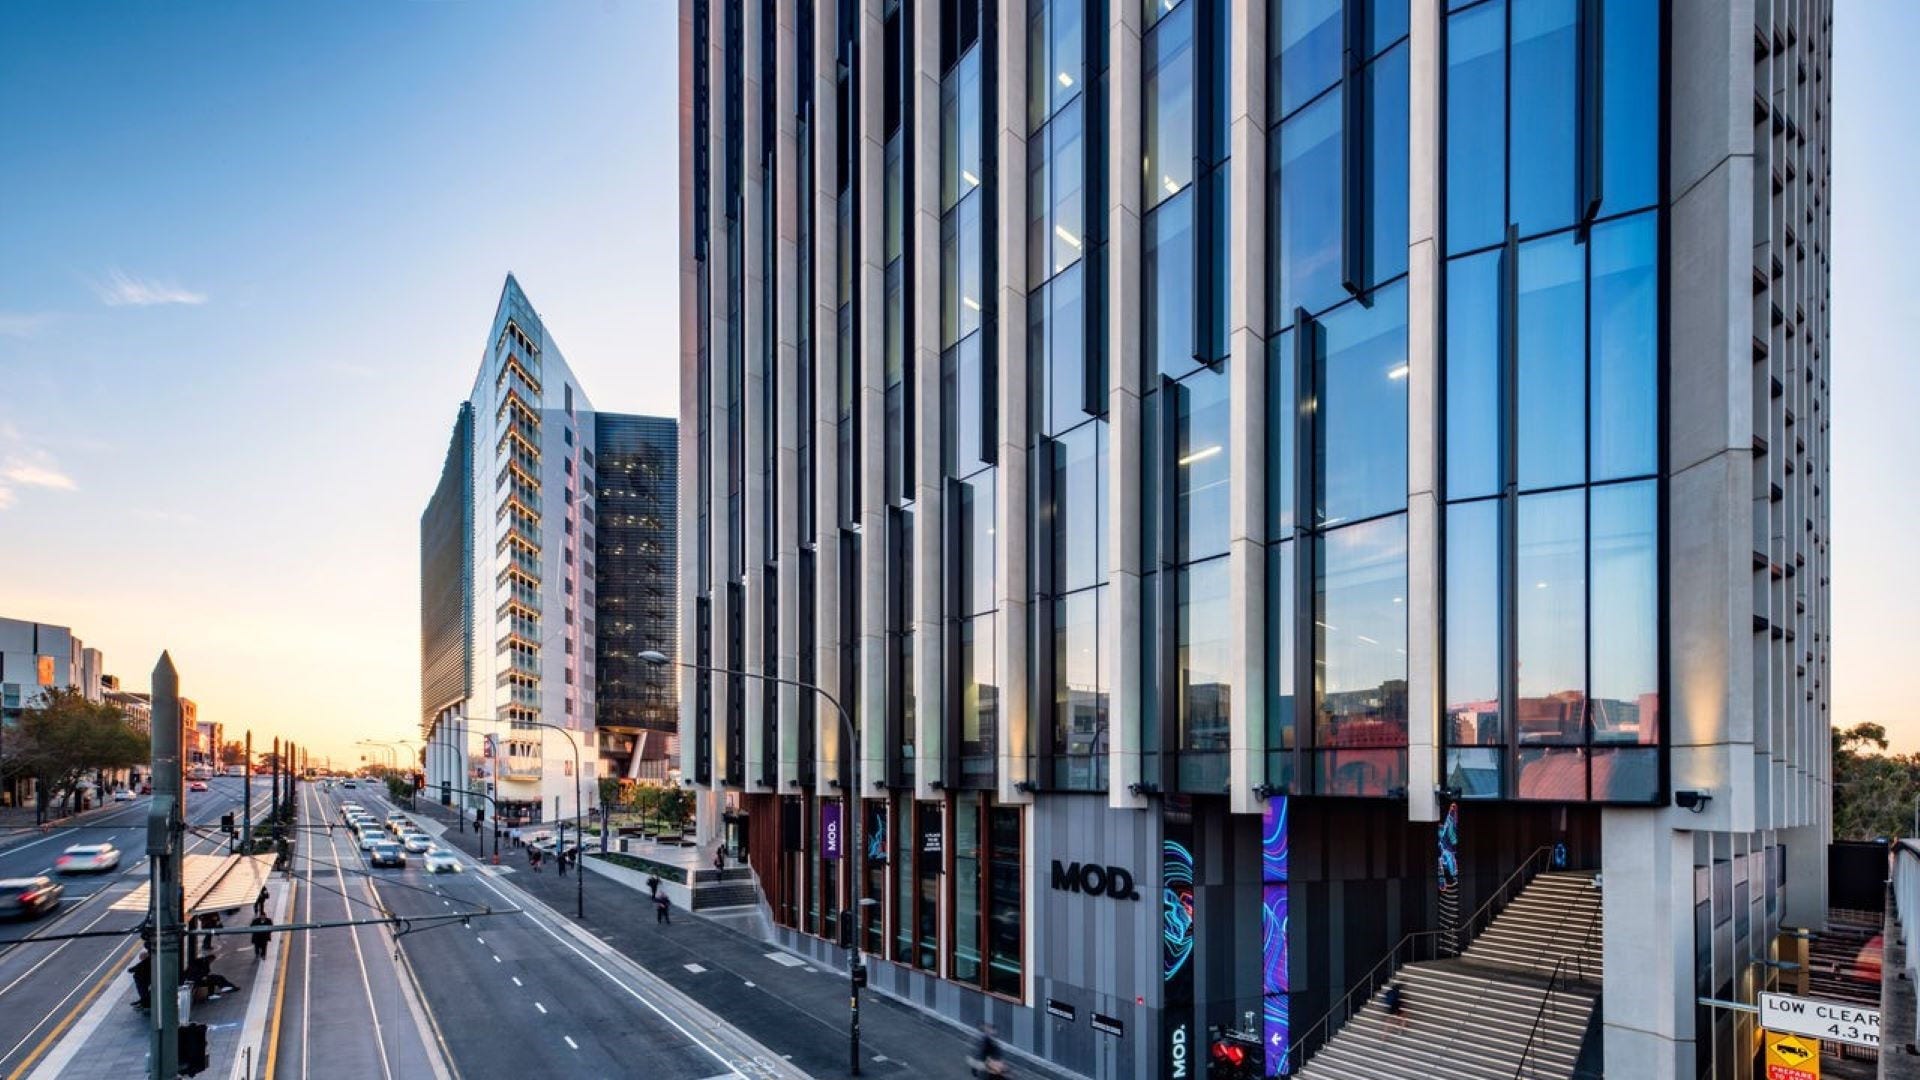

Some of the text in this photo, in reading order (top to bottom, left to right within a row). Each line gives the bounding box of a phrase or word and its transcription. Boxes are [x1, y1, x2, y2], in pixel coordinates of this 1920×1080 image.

[827, 820, 837, 851] MOD.
[1051, 859, 1140, 902] MOD.
[1769, 999, 1880, 1027] LOW CLEAR
[1173, 1023, 1187, 1079] MOD.
